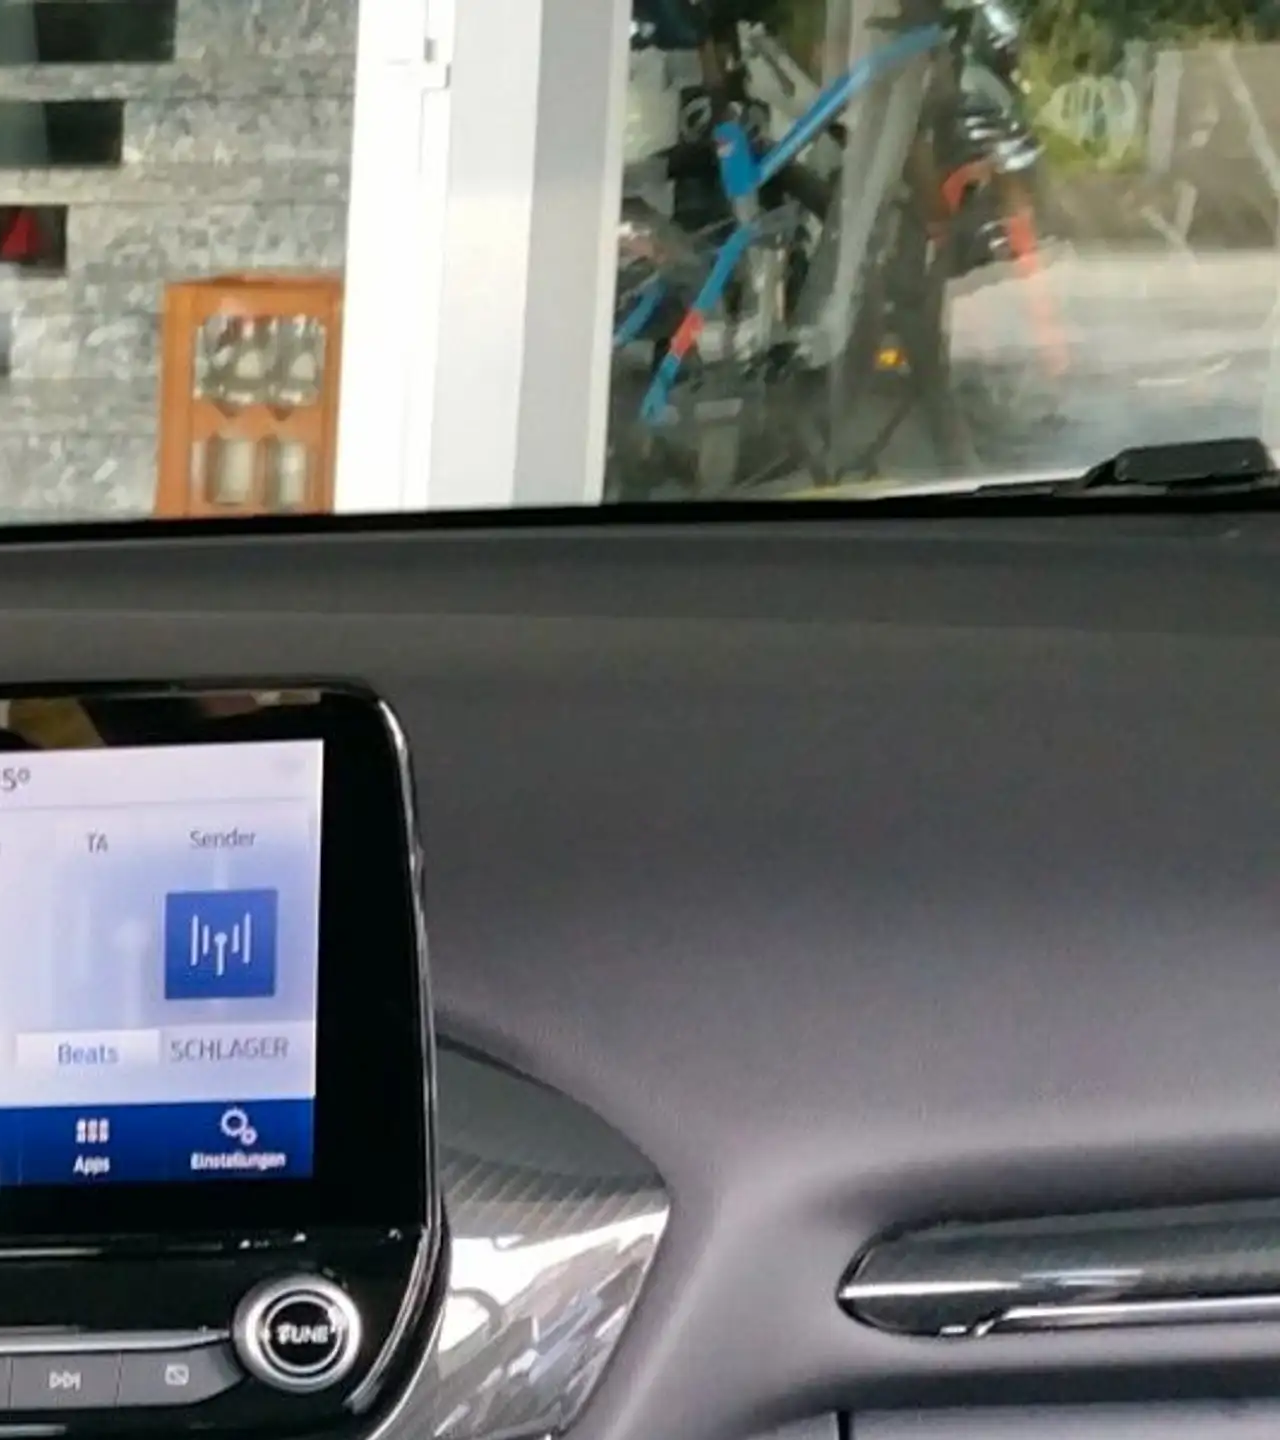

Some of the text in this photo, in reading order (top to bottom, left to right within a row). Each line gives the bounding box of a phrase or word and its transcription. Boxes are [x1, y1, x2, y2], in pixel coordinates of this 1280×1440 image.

[86, 832, 109, 853] TA
[190, 827, 256, 851] Sender
[57, 1042, 119, 1065] Beats
[170, 1036, 290, 1064] SCHLAGER
[73, 1155, 111, 1175] Apps
[190, 1151, 287, 1173] Einstellungen
[277, 1322, 329, 1344] TUNE
